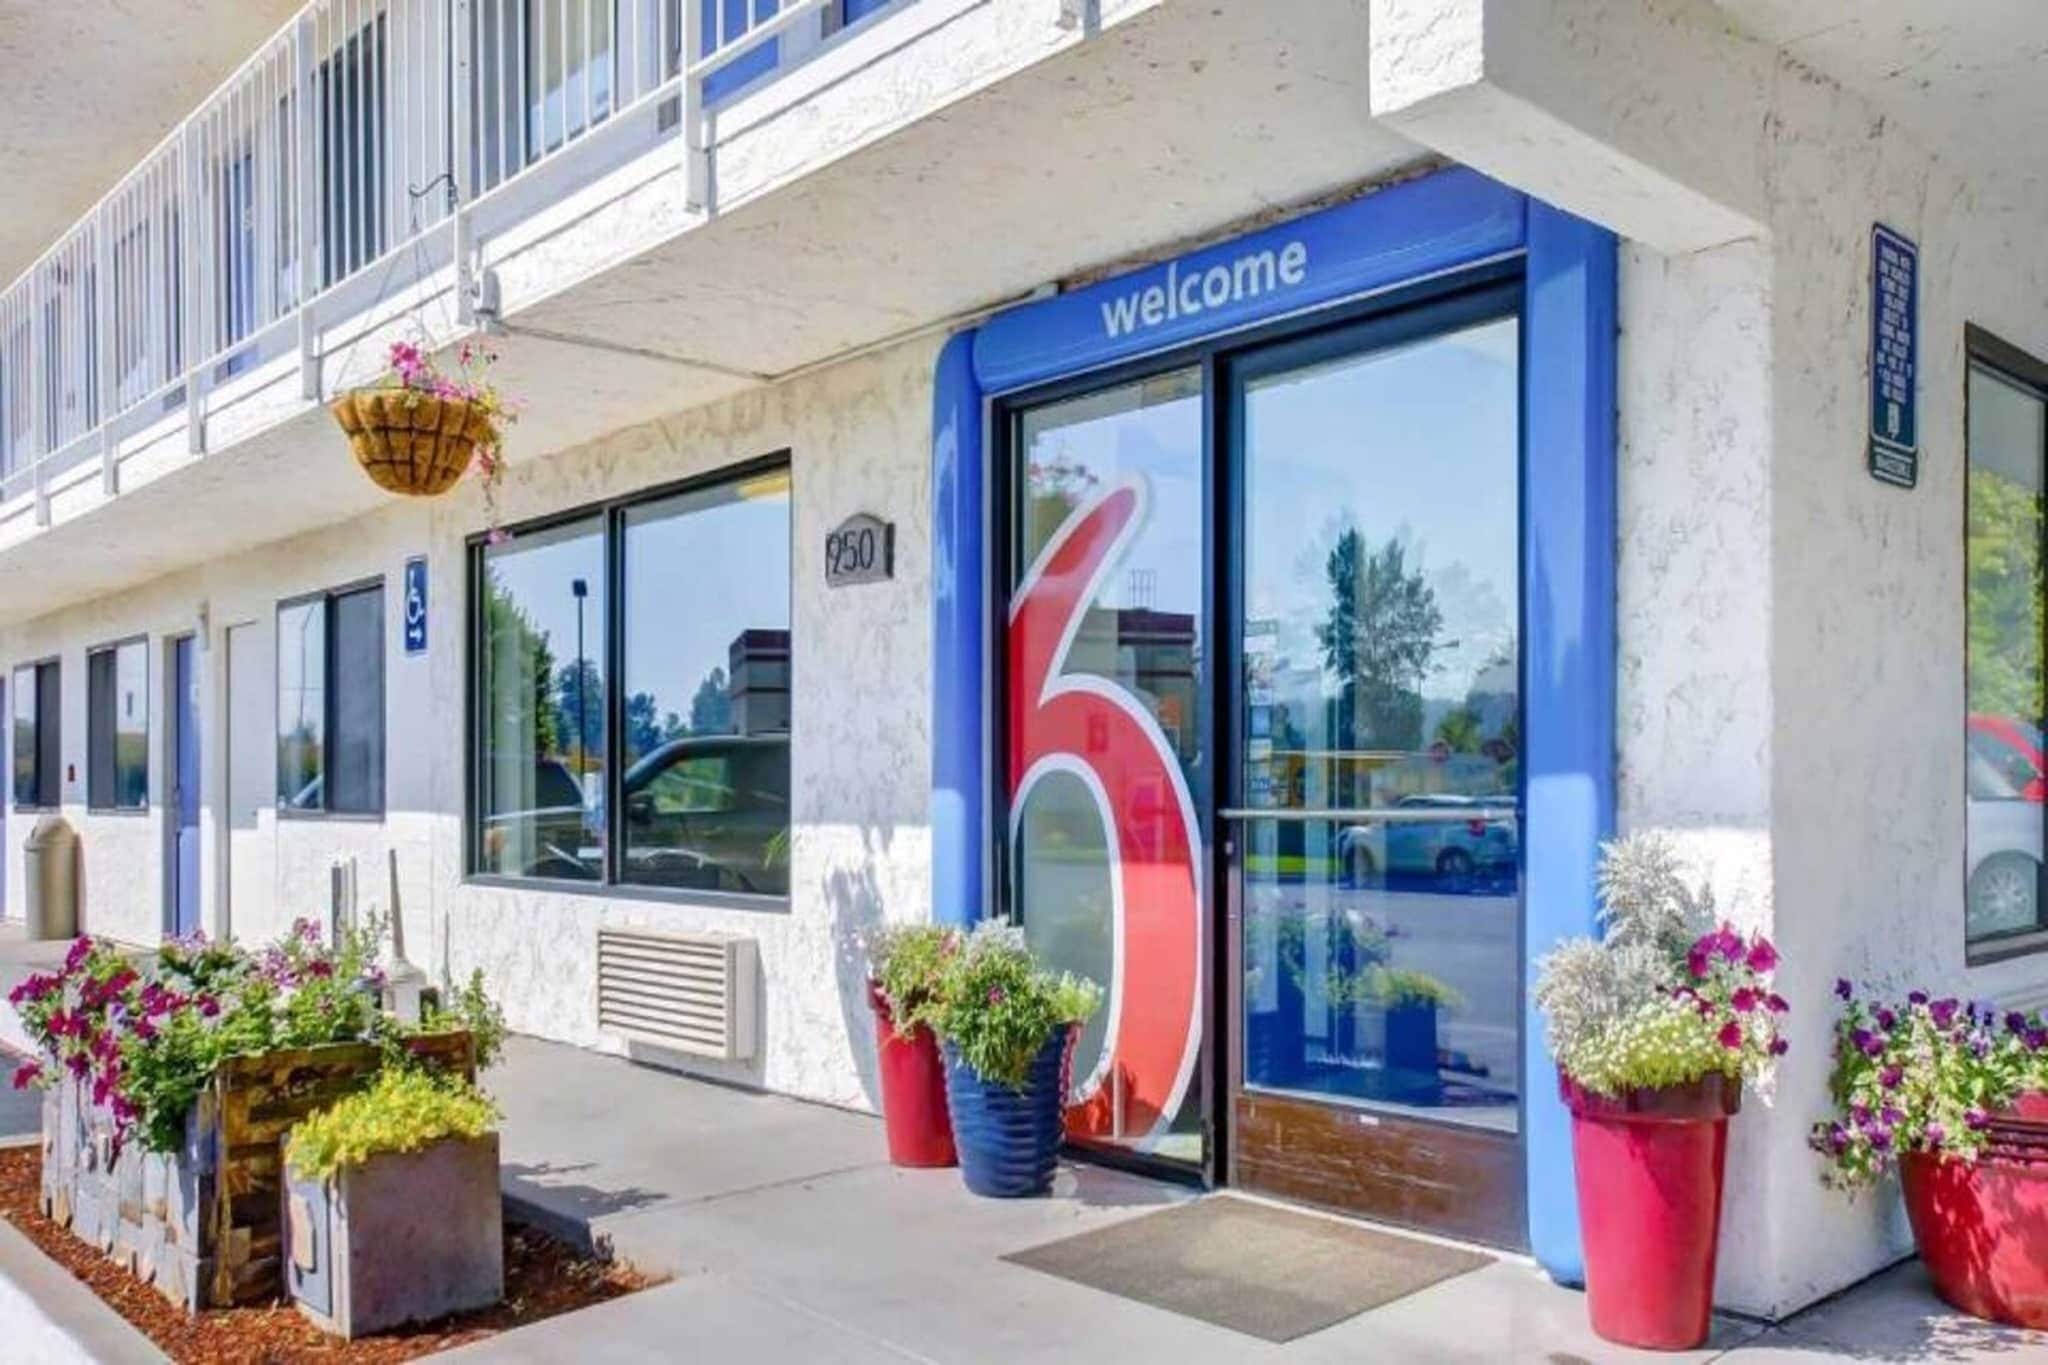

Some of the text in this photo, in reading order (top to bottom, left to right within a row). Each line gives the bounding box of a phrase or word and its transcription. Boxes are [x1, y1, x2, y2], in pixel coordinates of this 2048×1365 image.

[1102, 241, 1307, 338] welcome
[826, 528, 874, 574] 950
[1009, 471, 1204, 1153] 6
